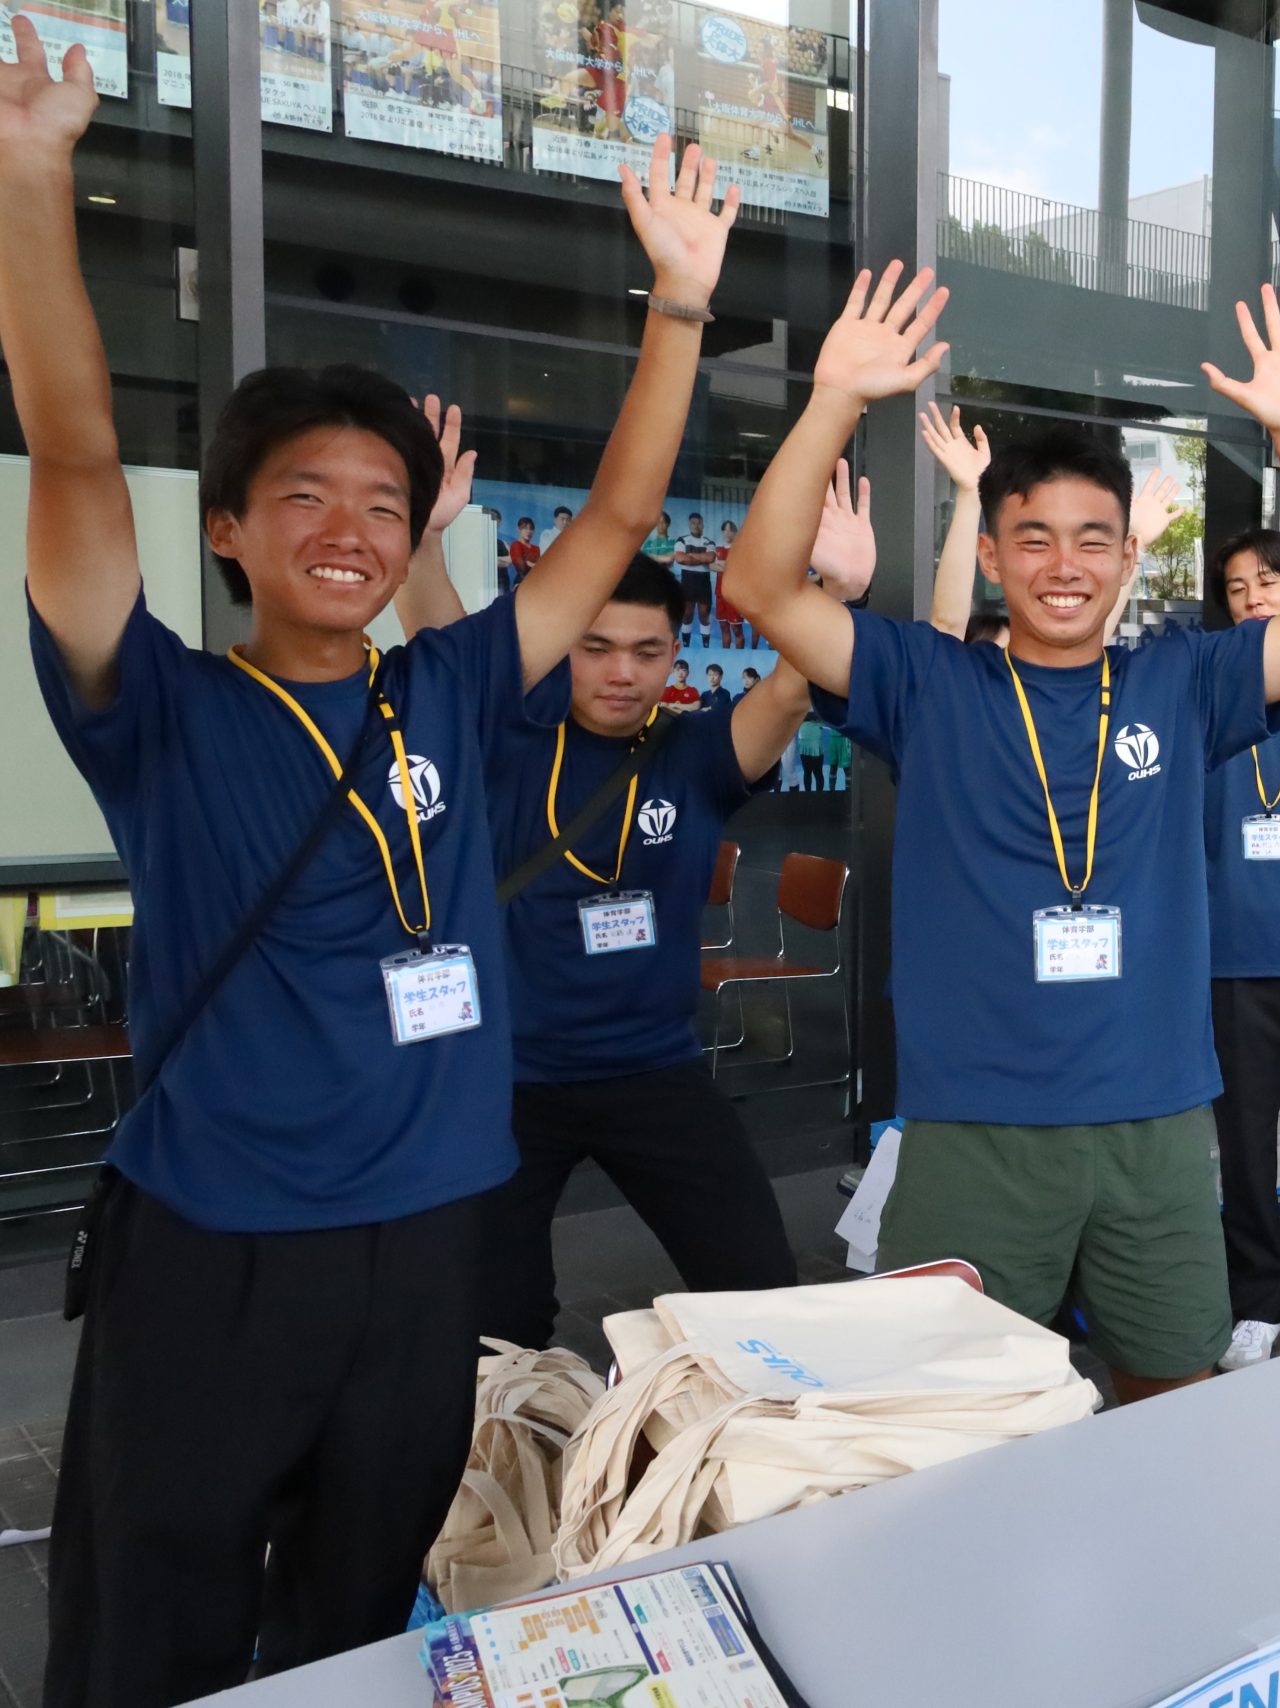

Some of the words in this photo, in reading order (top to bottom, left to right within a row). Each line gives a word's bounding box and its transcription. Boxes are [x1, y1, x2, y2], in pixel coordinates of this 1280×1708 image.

[708, 17, 745, 46] PRIDE
[630, 97, 668, 127] PRIDE
[1128, 764, 1162, 781] OUHS
[643, 833, 673, 846] OUHS
[592, 915, 645, 931] 学生スタッフ
[1062, 924, 1095, 934] 体育学部
[1047, 937, 1109, 951] 学生スタッフ
[402, 980, 468, 1005] 学生スタッフ
[736, 1339, 824, 1387] OUHS
[442, 1650, 478, 1678] 2023
